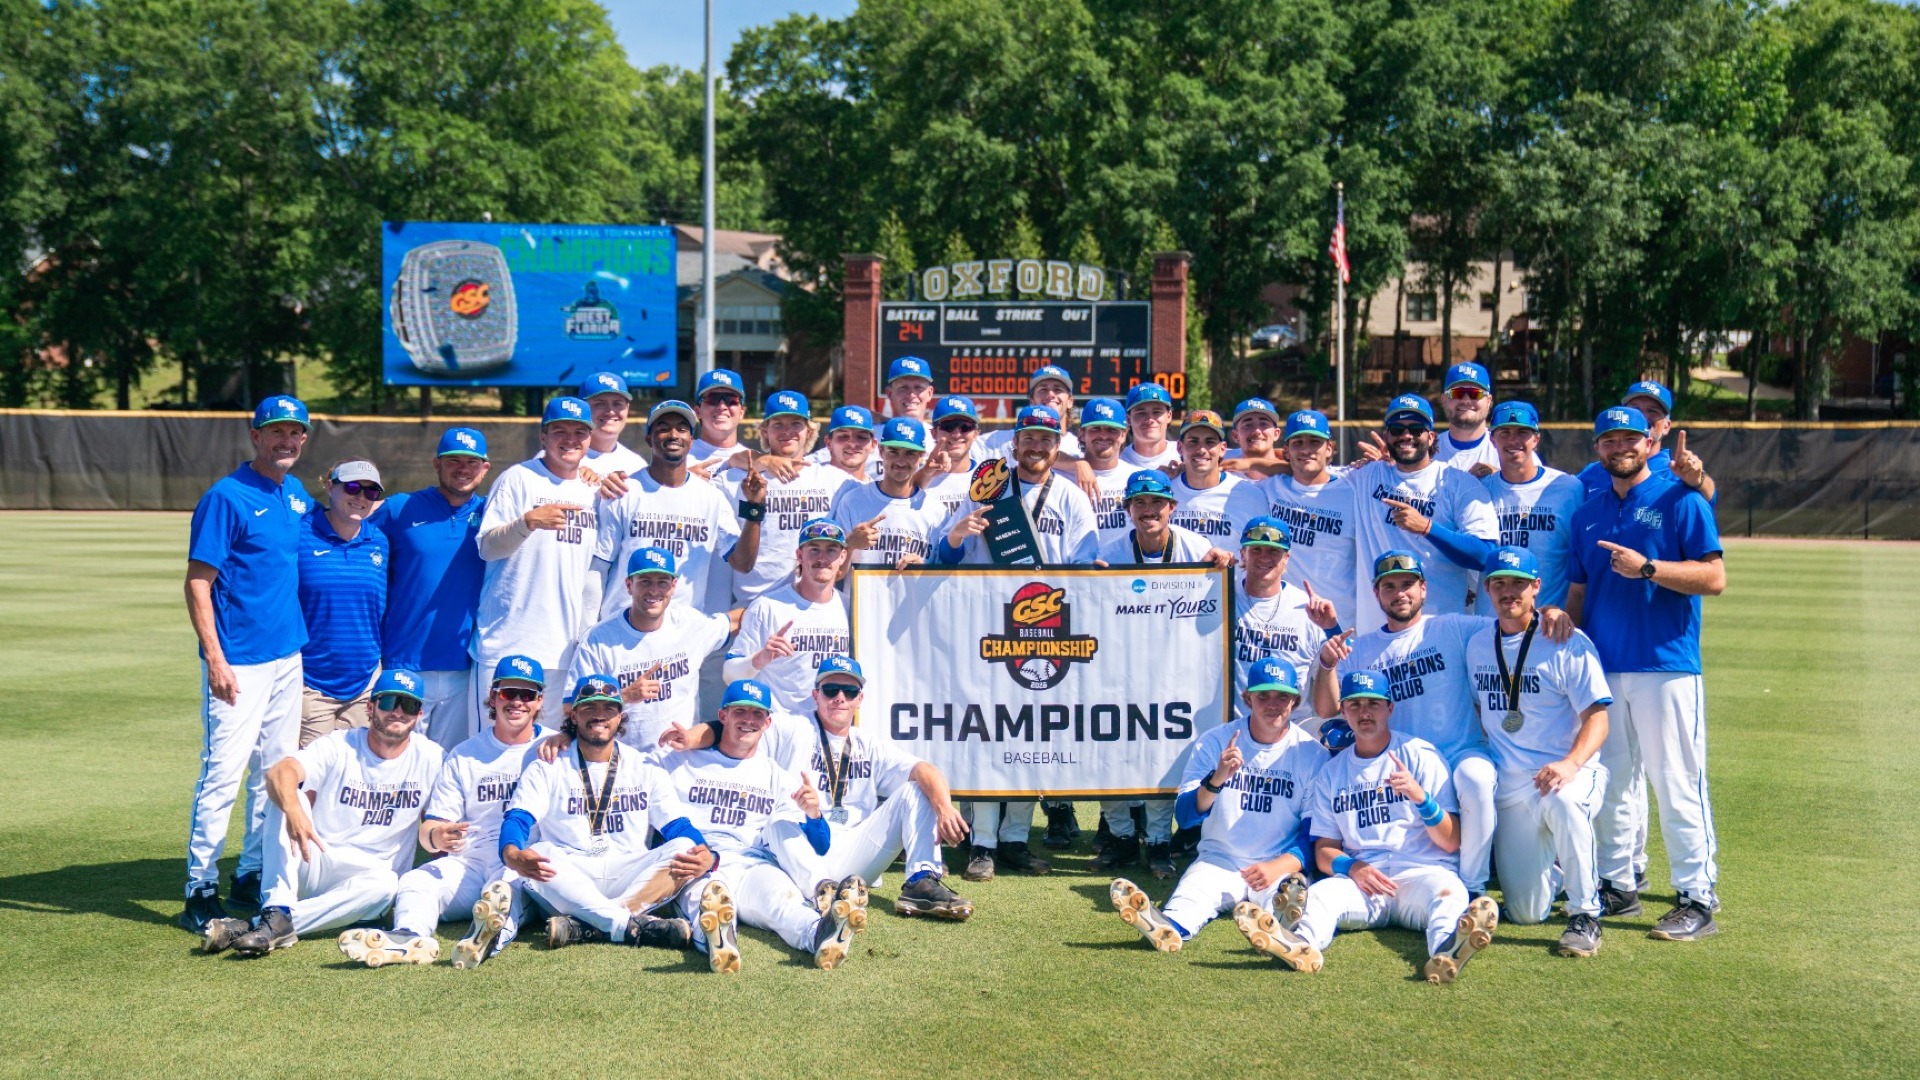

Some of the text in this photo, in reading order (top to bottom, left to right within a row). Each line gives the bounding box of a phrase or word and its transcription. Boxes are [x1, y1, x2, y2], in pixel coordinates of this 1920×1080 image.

[501, 237, 671, 275] CHAMPIONS
[923, 258, 1104, 301] OXFORD
[886, 309, 937, 321] BATTER
[946, 309, 1090, 321] BALL STRIKE OUT
[898, 321, 923, 341] 24
[1069, 348, 1094, 357] RUNS
[1100, 348, 1121, 357] HITS
[1080, 377, 1092, 393] 2
[970, 457, 1010, 502] GSC
[765, 496, 831, 513] HAMPIONS
[1097, 511, 1127, 530] CLUB
[1169, 518, 1232, 536] AMPIONS
[1272, 504, 1343, 535] CHAMPIONS
[1499, 513, 1556, 532] MPIONS
[556, 527, 582, 544] CLUB
[629, 520, 709, 542] CHAMPIONS
[1501, 531, 1530, 548] CLUB
[864, 534, 933, 559] AMPIONS
[884, 552, 908, 565] CL
[1151, 581, 1196, 590] DIVISION
[1012, 590, 1063, 625] GSC
[1115, 604, 1151, 615] MAKE
[1154, 604, 1167, 614] IT
[1019, 628, 1055, 638] BASEBALL
[1235, 626, 1298, 651] AMPIONS
[791, 635, 849, 652] CHAMPIO
[982, 639, 1096, 658] CHAMPIONSHIP
[1380, 653, 1446, 684] AMPIONS
[644, 682, 672, 704] UB
[1391, 677, 1425, 702] CLUB
[1474, 673, 1540, 693] HAMNS
[1488, 692, 1508, 711] CLU
[890, 701, 1193, 742] CHAMPIONS
[1003, 751, 1077, 765] BASEBALL
[339, 786, 421, 810] CHAMPIONS
[568, 792, 648, 815] CHIONS
[689, 786, 775, 816] CHAMPIONS
[1240, 792, 1273, 813] CLUB
[1333, 786, 1411, 814] CHAMPIO
[361, 808, 395, 826] CLUB
[603, 814, 624, 833] UB
[710, 806, 747, 827] CLUB
[1357, 805, 1391, 828] CLUB
